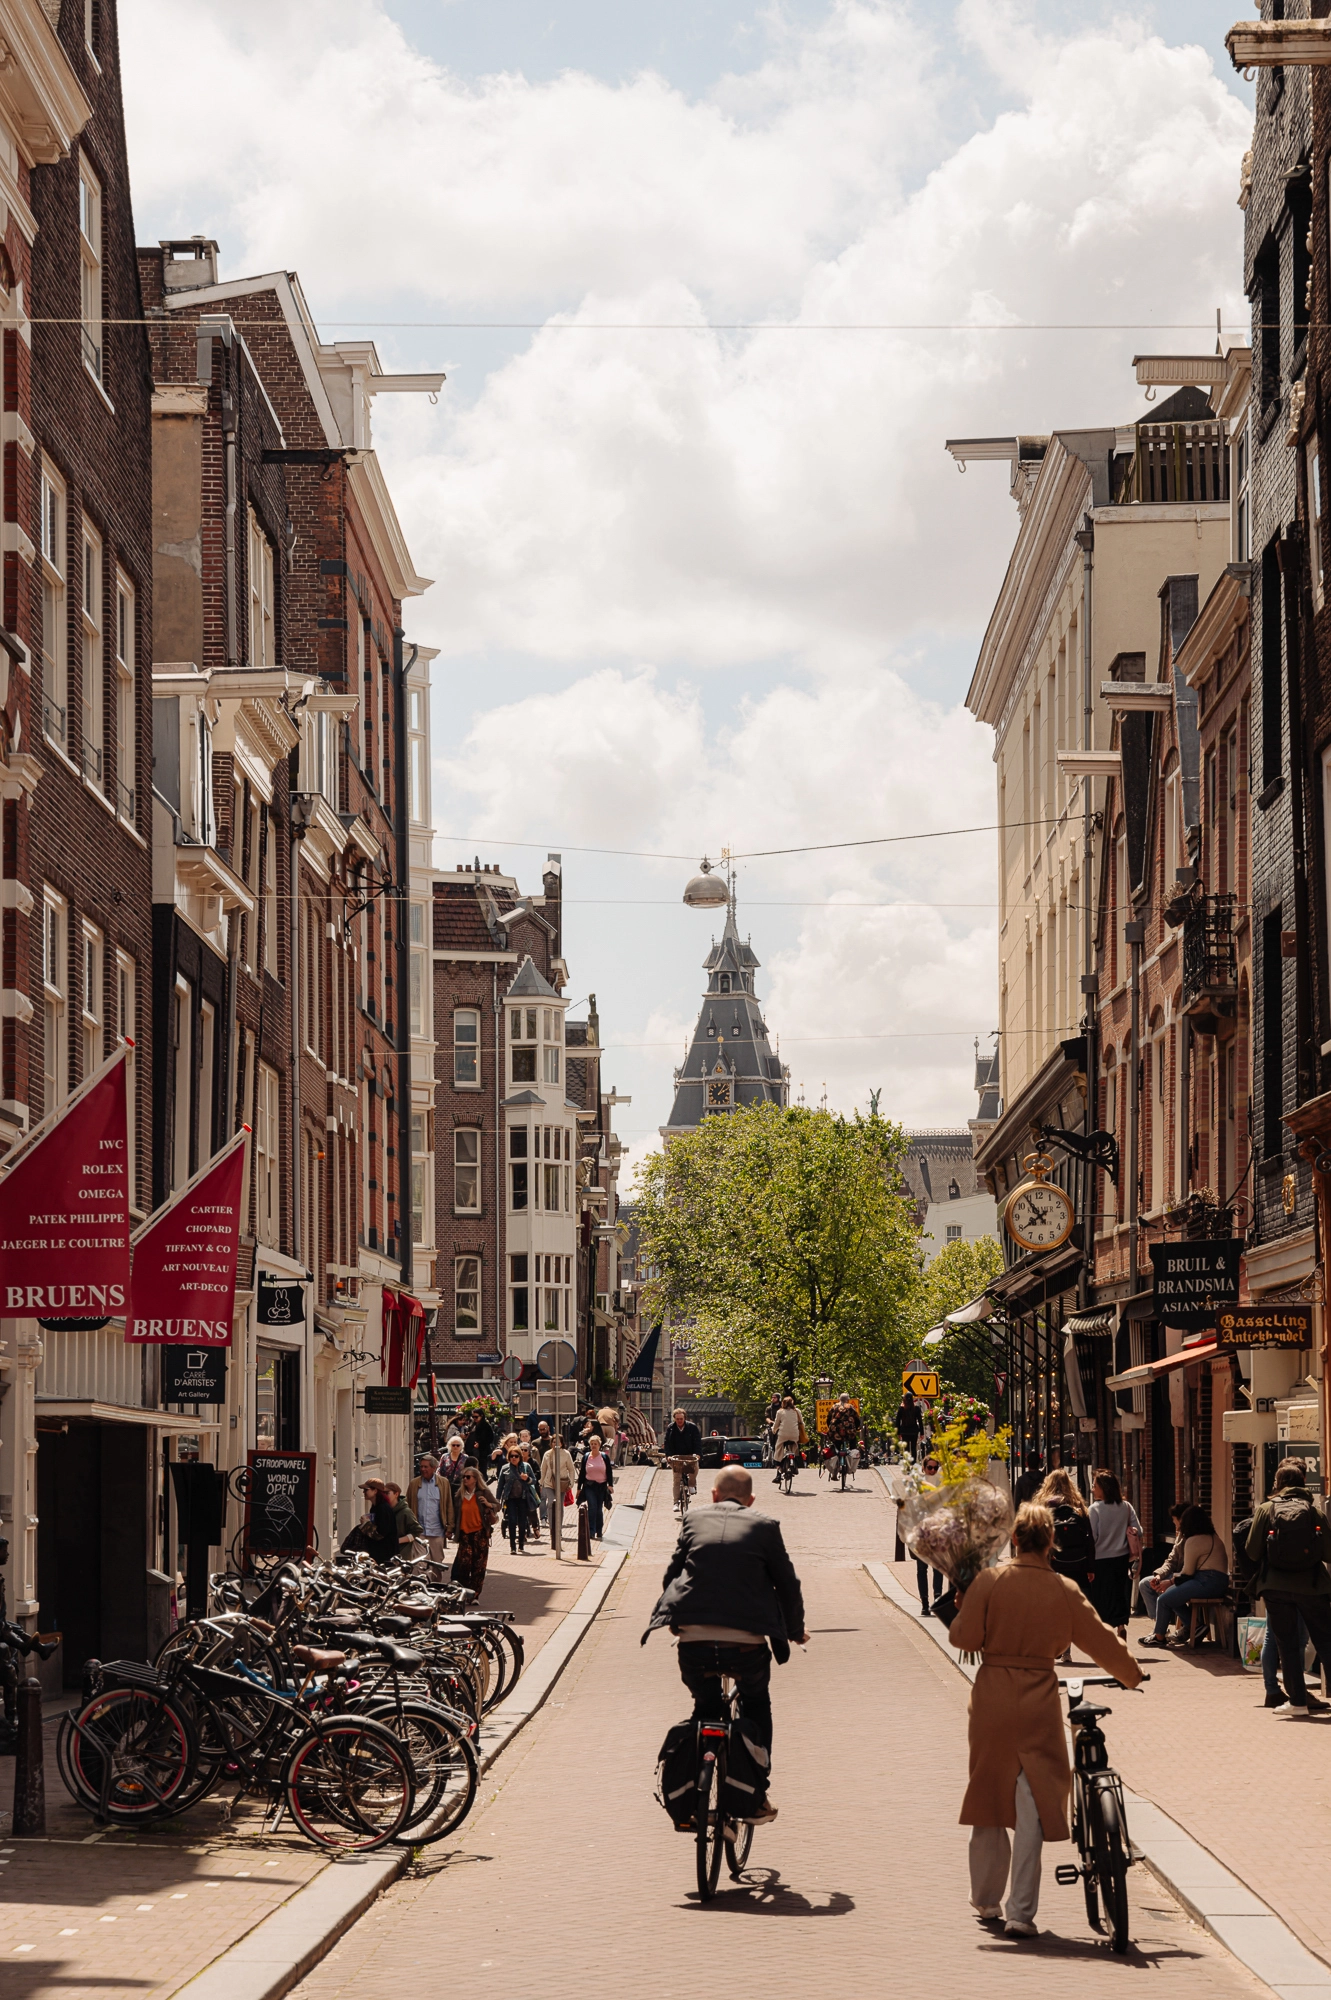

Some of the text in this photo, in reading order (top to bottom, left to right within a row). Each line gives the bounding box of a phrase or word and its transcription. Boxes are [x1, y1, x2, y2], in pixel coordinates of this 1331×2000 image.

[99, 1140, 124, 1150] IWC
[82, 1164, 124, 1174] ROLEX
[78, 1189, 124, 1199] OMEGA
[191, 1206, 233, 1214] CARTIER
[29, 1214, 125, 1224] PATEK PHILIPPE
[186, 1225, 232, 1234] CHOPARD
[1050, 1231, 1054, 1239] 5
[1, 1239, 125, 1250] JAEGER LE COULTRE
[165, 1244, 204, 1252] TIFFANY
[216, 1245, 231, 1253] CO
[182, 1263, 230, 1273] NOUVEAU
[1167, 1256, 1226, 1272] BRUIL &
[180, 1283, 228, 1292] ART-DECO
[1158, 1278, 1235, 1294] BRANDSMA
[5, 1284, 125, 1308] BRUENS
[1162, 1301, 1199, 1312] ASIAN
[132, 1319, 228, 1340] BRUENS
[183, 1370, 206, 1378] CARRÉ
[920, 1379, 930, 1391] V
[267, 1474, 300, 1484] WORLD
[266, 1483, 295, 1495] OPEN
